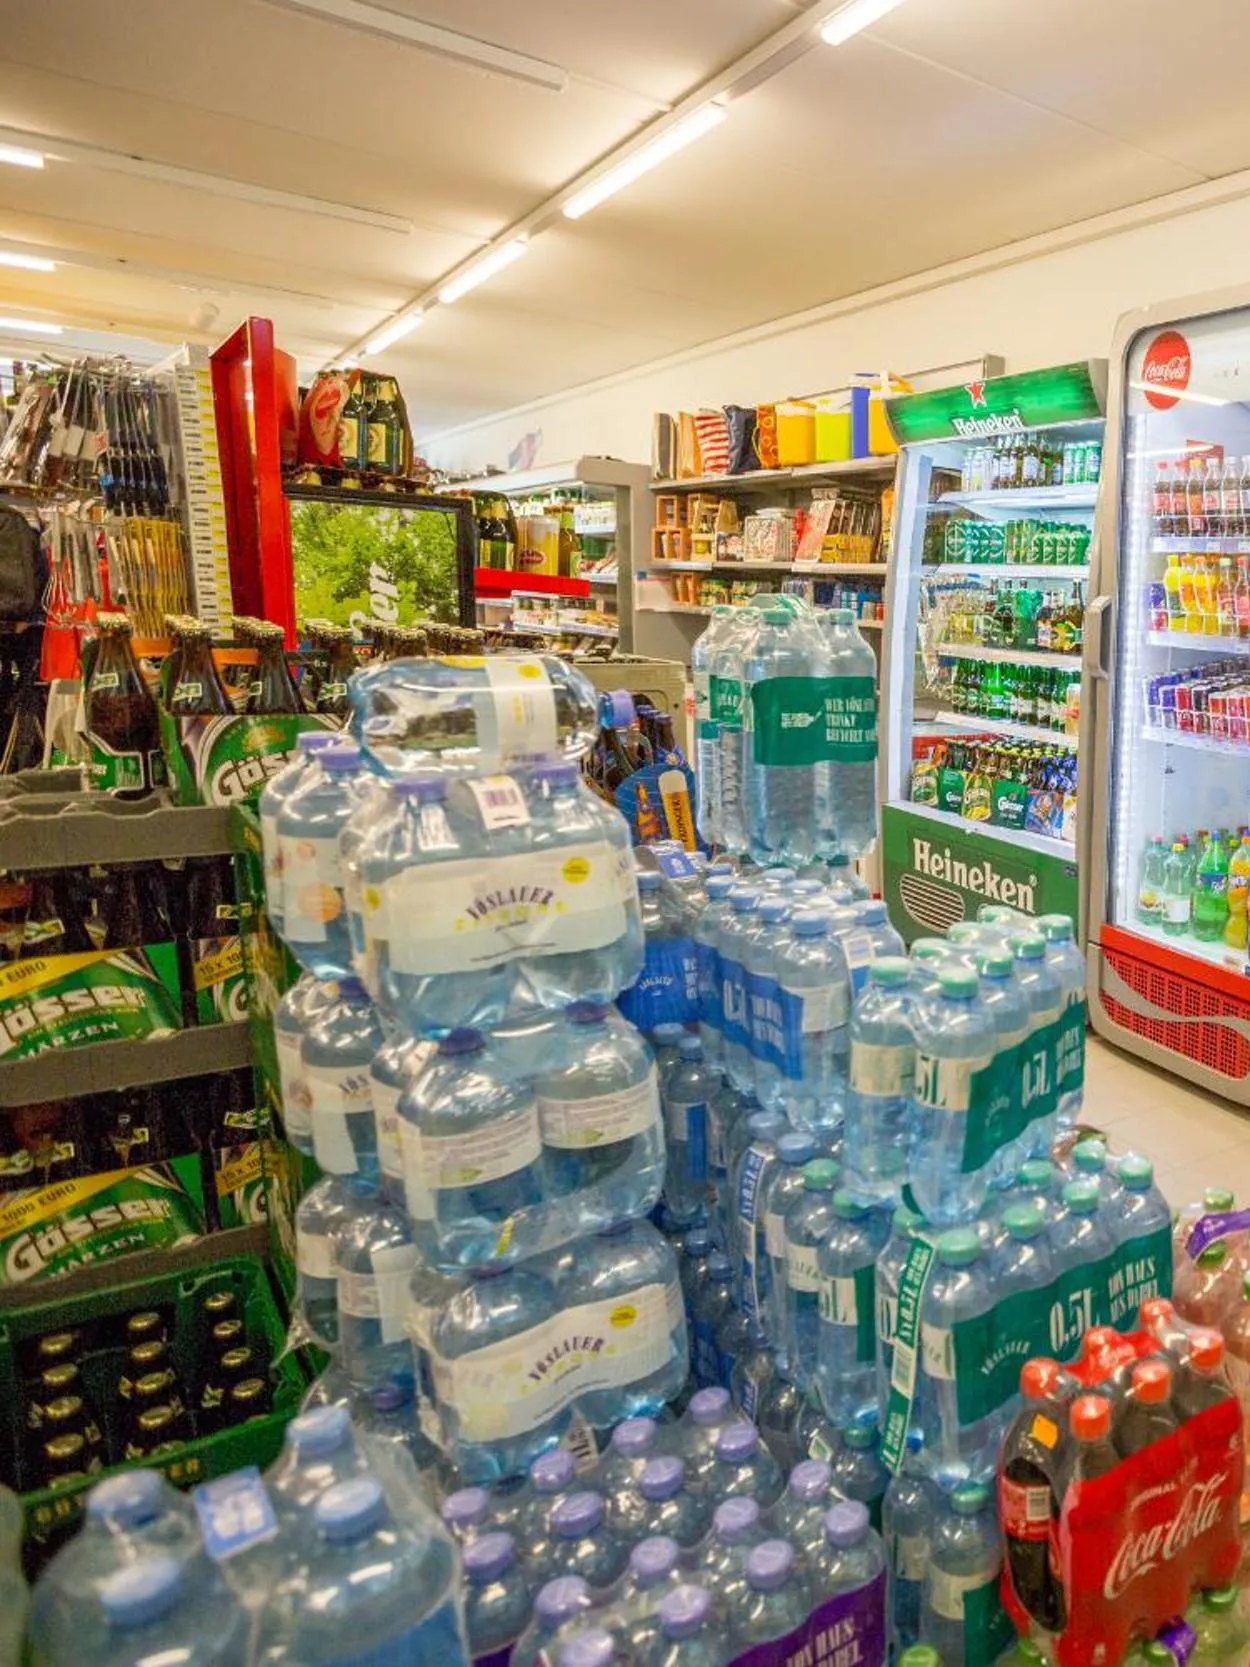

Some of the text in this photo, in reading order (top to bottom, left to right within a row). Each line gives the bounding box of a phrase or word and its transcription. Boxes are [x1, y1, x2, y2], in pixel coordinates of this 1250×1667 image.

[1145, 356, 1190, 382] Coca-Cola
[952, 411, 1024, 437] Heineken
[913, 837, 1036, 912] Heineken
[6, 960, 47, 984] EURO
[39, 1182, 77, 1207] EURO
[5, 1198, 171, 1283] Gösser
[1050, 1287, 1101, 1352] 0.5L
[527, 1335, 606, 1383] VÖSLAUER
[1104, 1471, 1230, 1602] Coca-Cola
